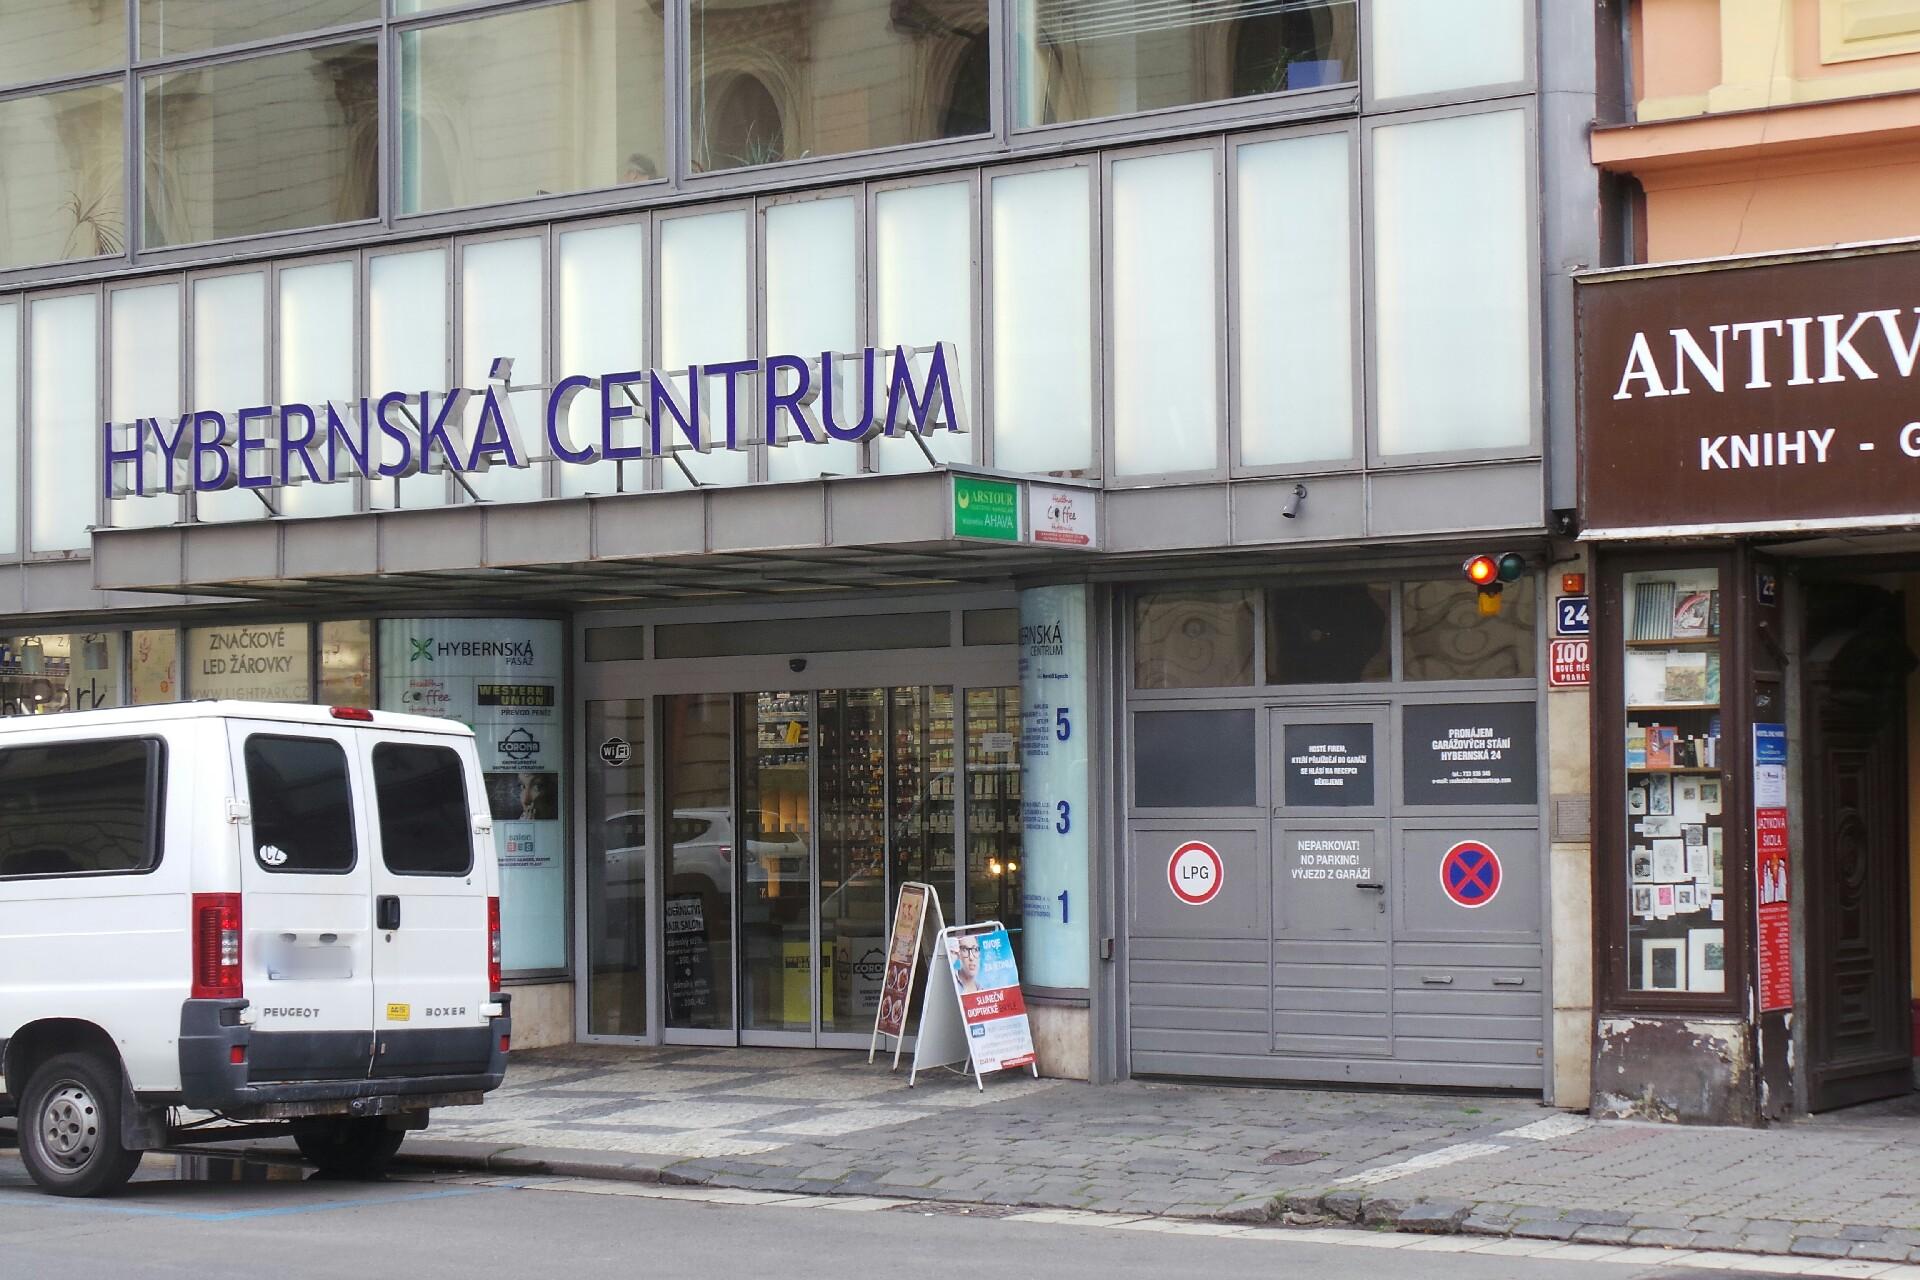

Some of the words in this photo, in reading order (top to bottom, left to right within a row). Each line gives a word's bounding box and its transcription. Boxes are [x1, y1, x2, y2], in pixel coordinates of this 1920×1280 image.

[104, 357, 529, 499] HYBERNSKÁ
[546, 340, 969, 464] CENTRUM
[1700, 428, 1836, 471] KNIHY
[971, 489, 1014, 506] ARSTOUR
[984, 513, 1014, 529] AHAVA
[1564, 605, 1589, 626] 24
[209, 627, 285, 650] ZNAČKOVÉ
[438, 640, 534, 657] HYBERNSKÁ
[203, 659, 226, 675] LED
[230, 653, 293, 674] ŽÁROVKY
[479, 686, 544, 696] WESTERN
[501, 696, 544, 705] UNION
[1056, 707, 1071, 741] 5
[1448, 727, 1494, 738] PRONÁJEM
[1486, 737, 1511, 749] STÁNÍ
[1441, 749, 1489, 760] HYBERNSKÁ
[1490, 750, 1502, 760] 24
[1056, 800, 1070, 834] 3
[1297, 840, 1360, 851] NEPARKOVAT!
[1300, 855, 1315, 865] NO
[1316, 855, 1360, 865] PARKING!
[1183, 866, 1209, 880] LPG
[1291, 868, 1326, 879] VÝJEZD
[1327, 870, 1334, 879] Z
[1335, 867, 1371, 879] GARÁŽÍ
[1057, 890, 1069, 924] 1
[263, 1007, 320, 1018] PEUGEOT
[425, 1006, 466, 1017] BOXER
